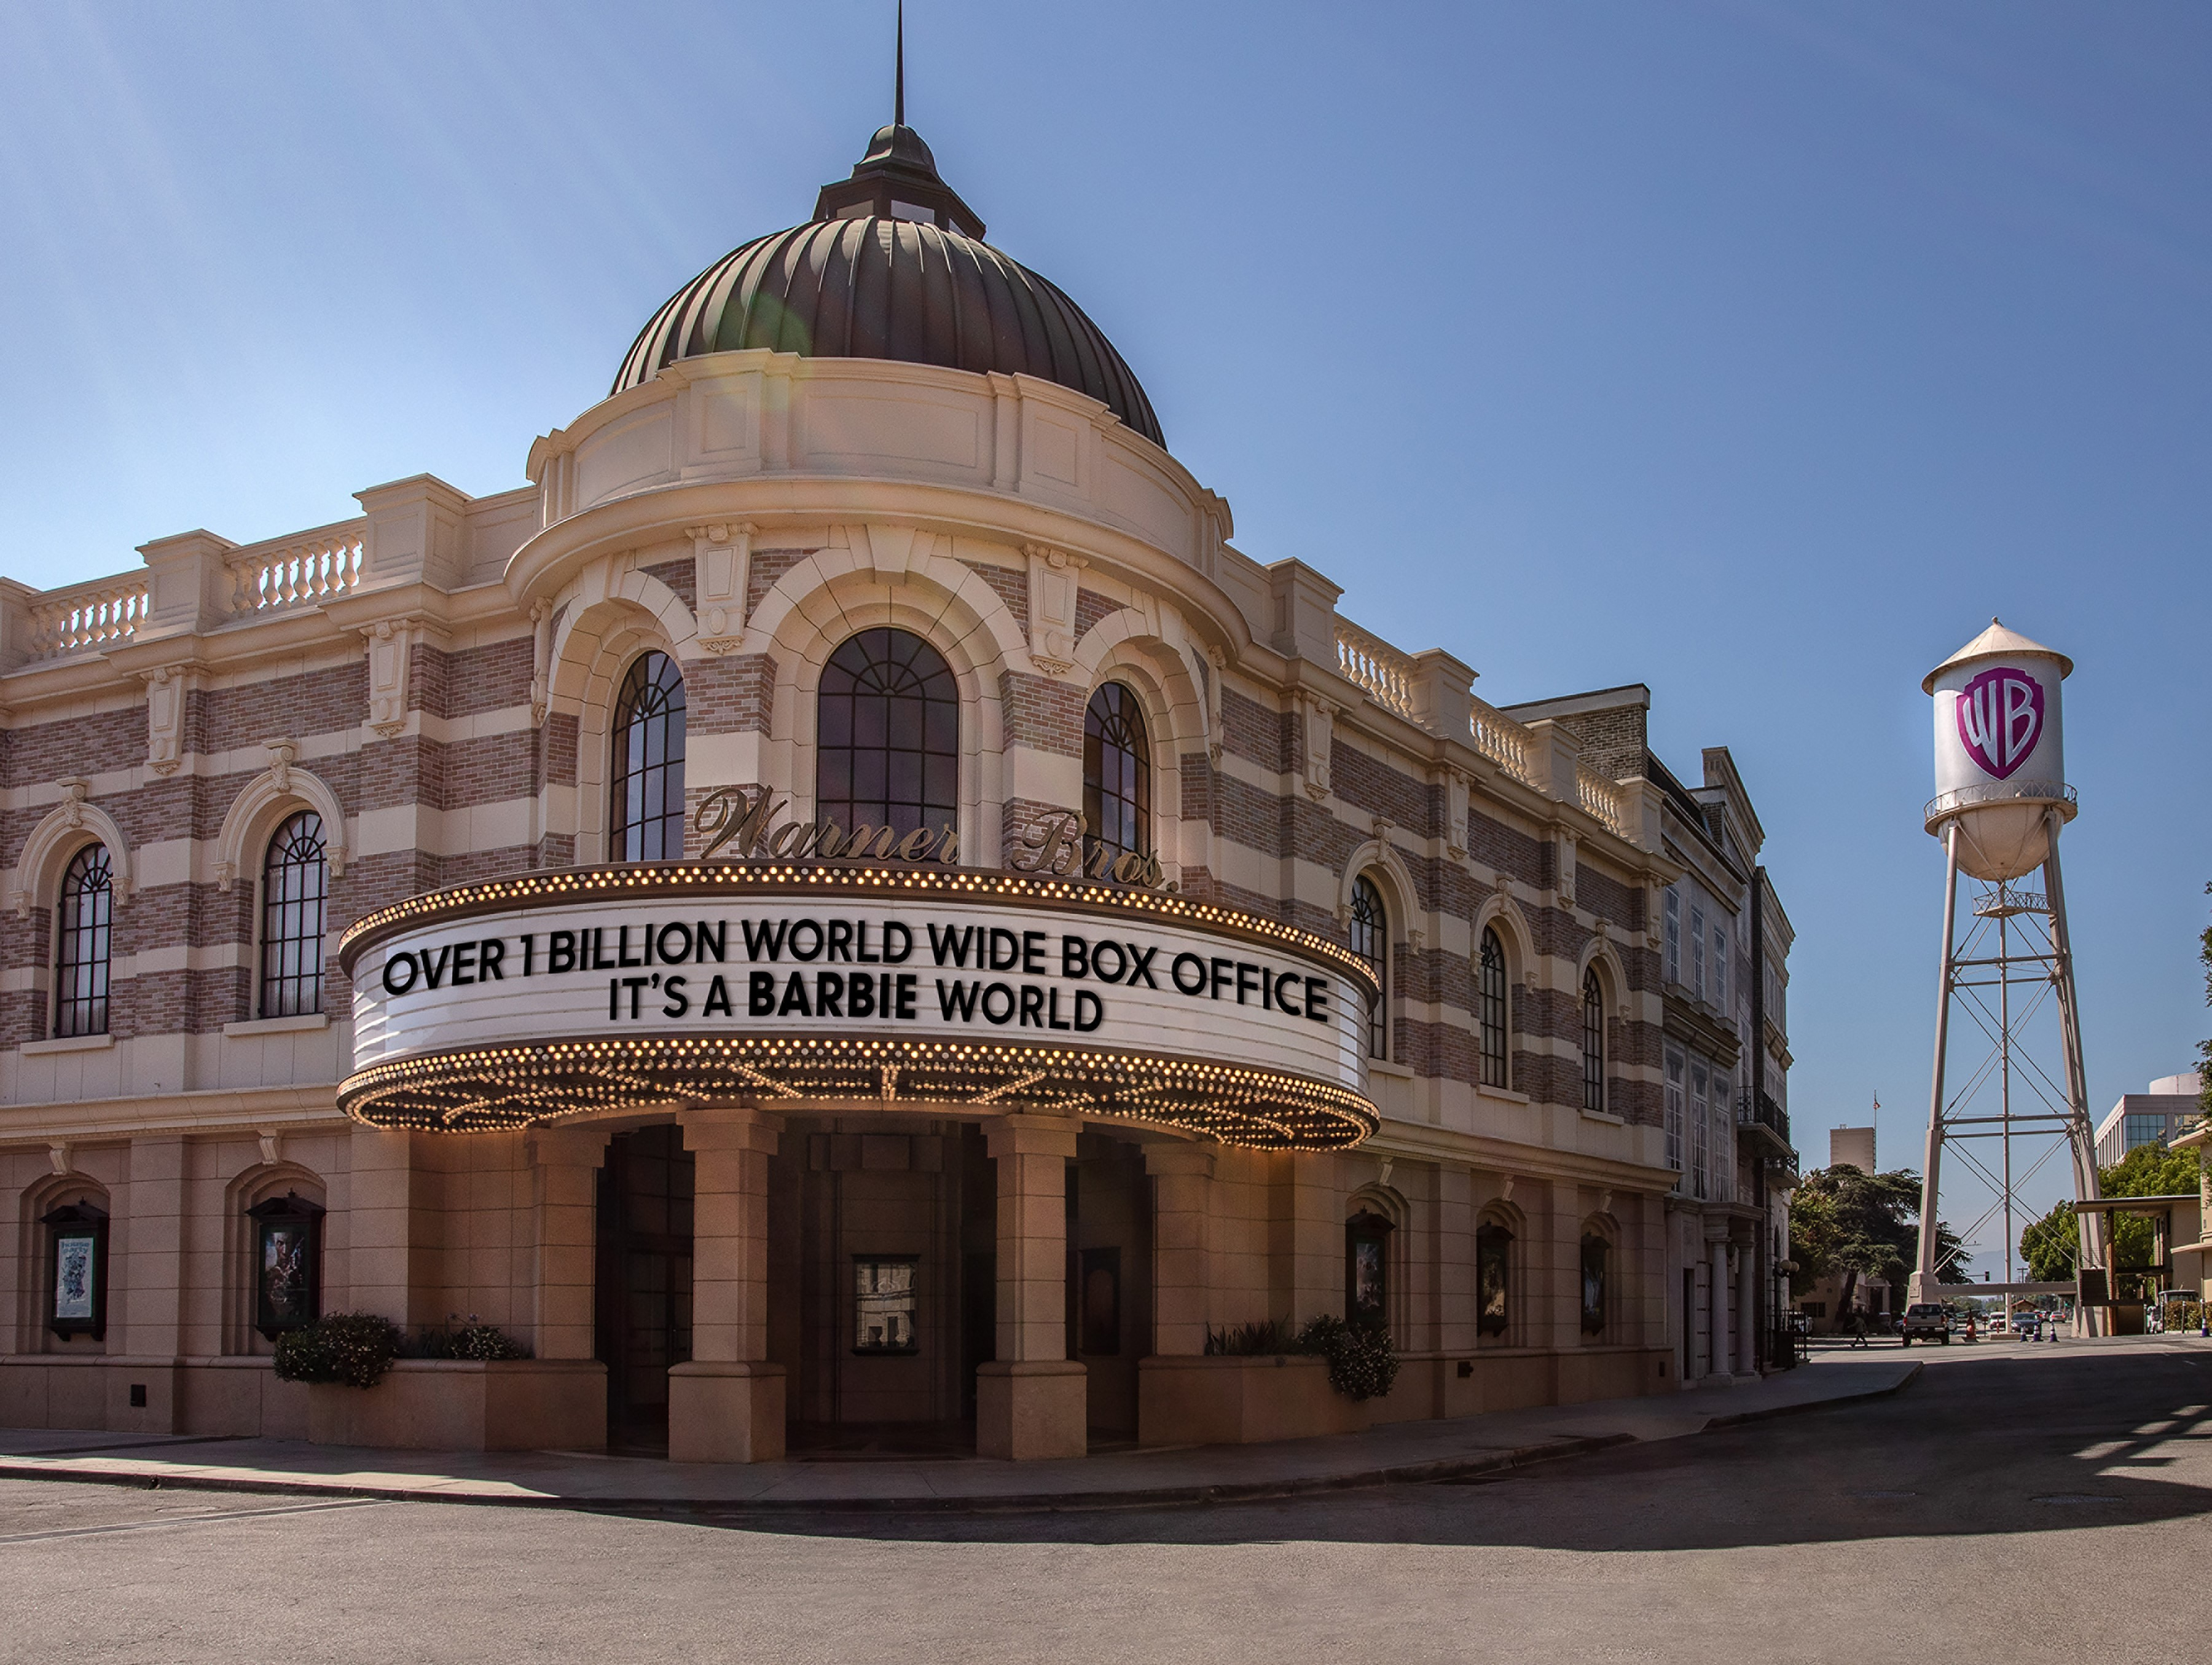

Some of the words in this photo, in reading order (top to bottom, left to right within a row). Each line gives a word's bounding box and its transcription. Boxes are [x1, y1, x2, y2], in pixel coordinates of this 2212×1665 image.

[1963, 679, 2036, 768] WB
[696, 784, 960, 864] Warner
[1011, 808, 1179, 892] Bros.
[383, 938, 506, 996] OVER
[520, 934, 533, 977] 1
[548, 920, 726, 975] BILLION
[741, 919, 913, 964] WORLD
[927, 923, 1046, 975] WIDE
[1062, 934, 1158, 990] BOX
[1171, 952, 1328, 1023] OFFICE
[610, 973, 689, 1020] IT'S
[702, 975, 732, 1017] A
[748, 971, 917, 1020] BARBIE
[935, 979, 1104, 1032] WORLD
